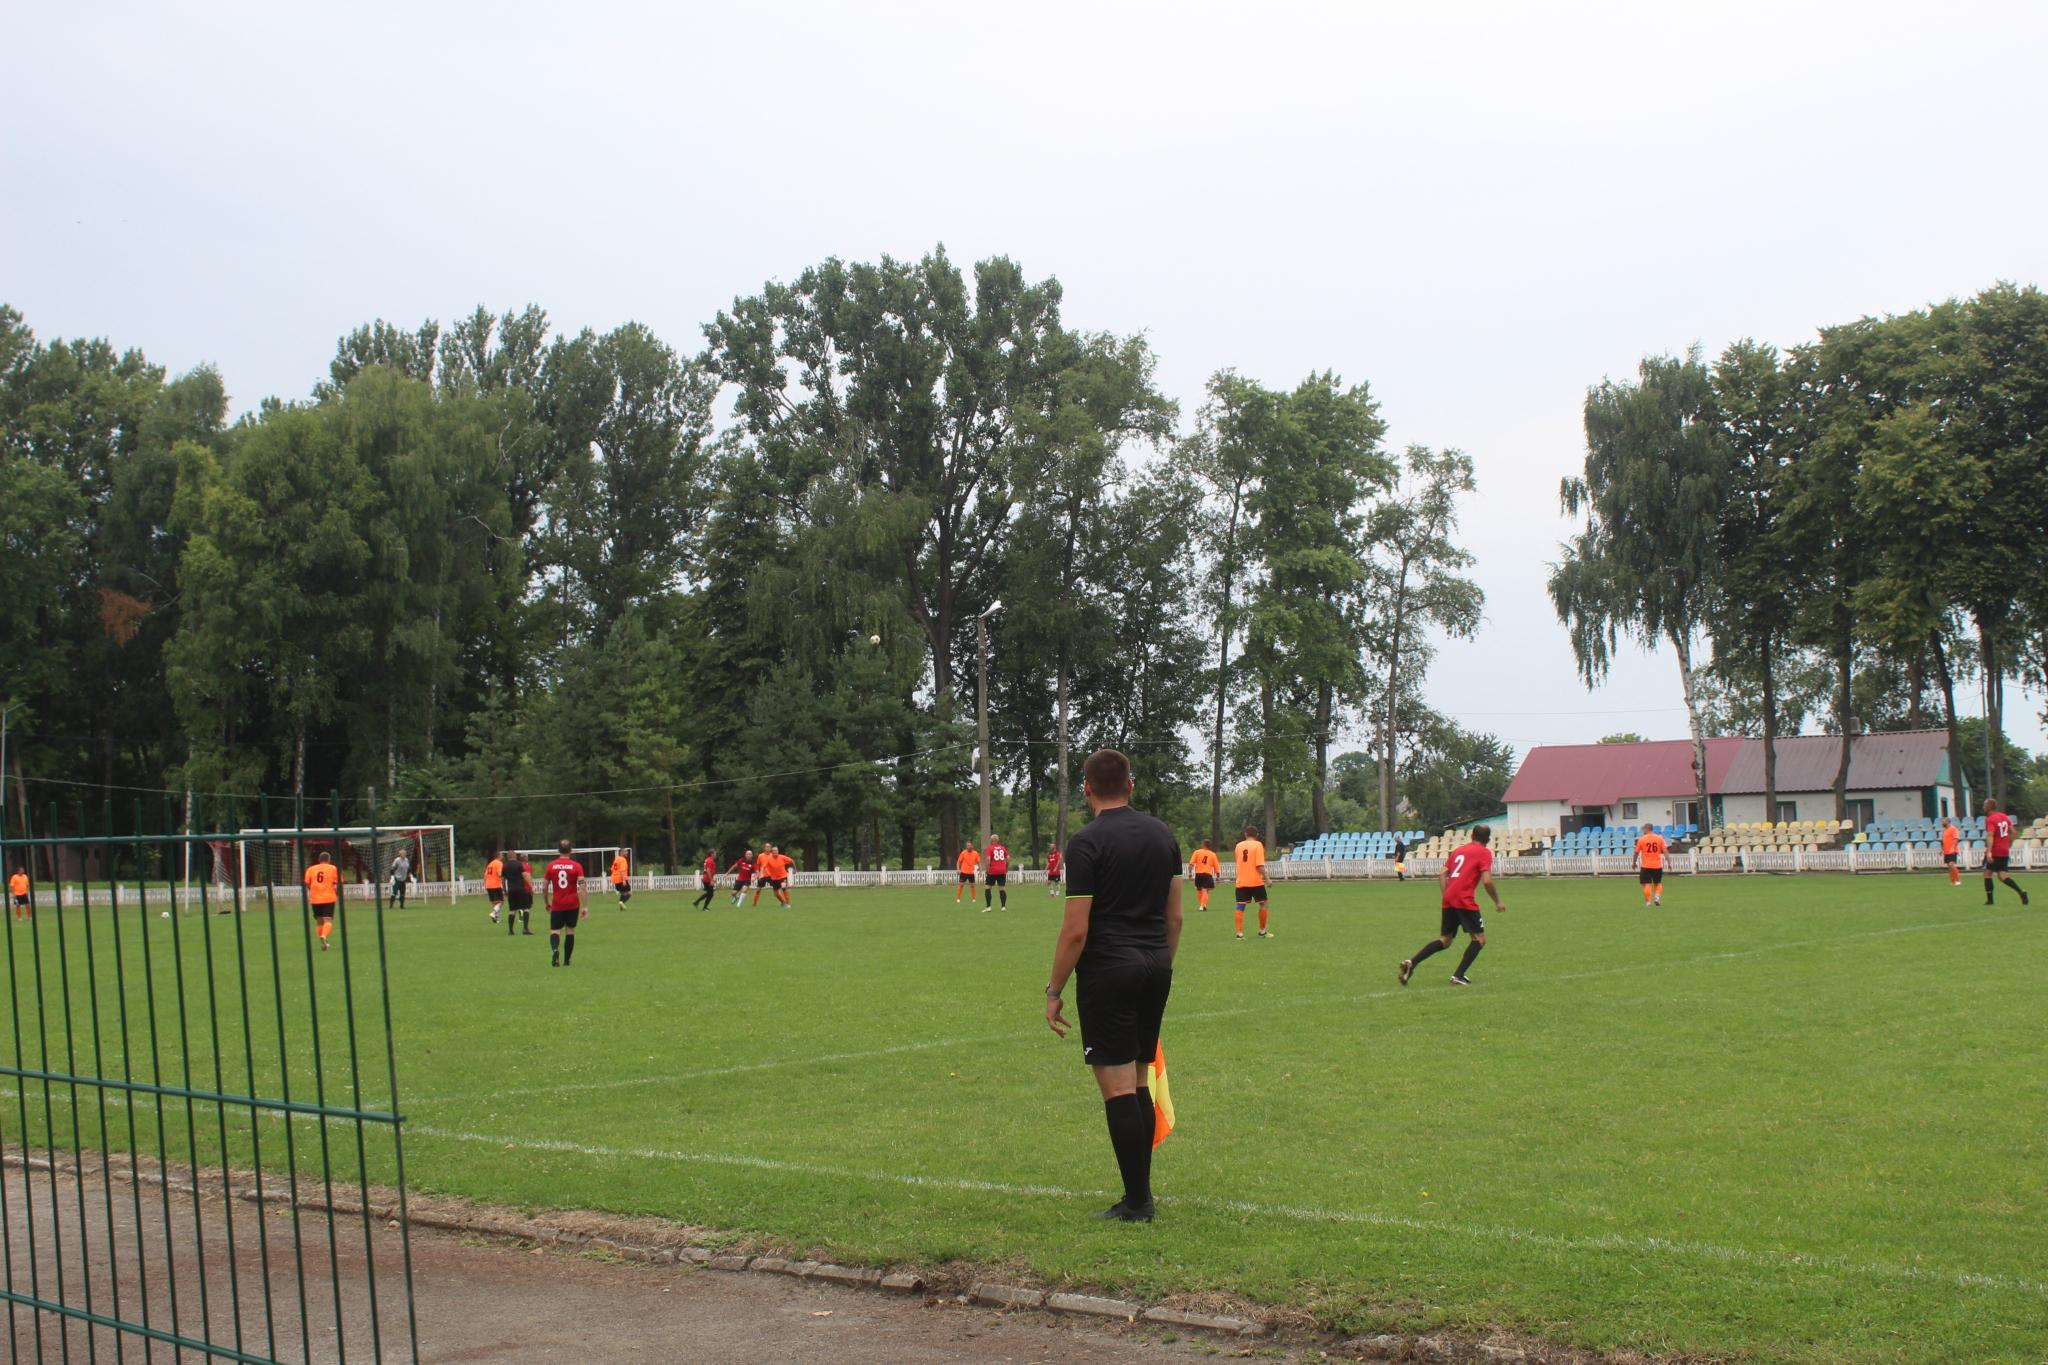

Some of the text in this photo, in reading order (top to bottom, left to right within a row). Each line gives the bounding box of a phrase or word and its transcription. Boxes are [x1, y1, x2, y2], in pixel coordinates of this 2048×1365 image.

[1998, 821, 2008, 837] 12
[994, 849, 1004, 861] 88
[1646, 843, 1658, 853] 26
[1451, 854, 1464, 877] 2
[317, 871, 324, 883] 6
[558, 870, 568, 888] 8
